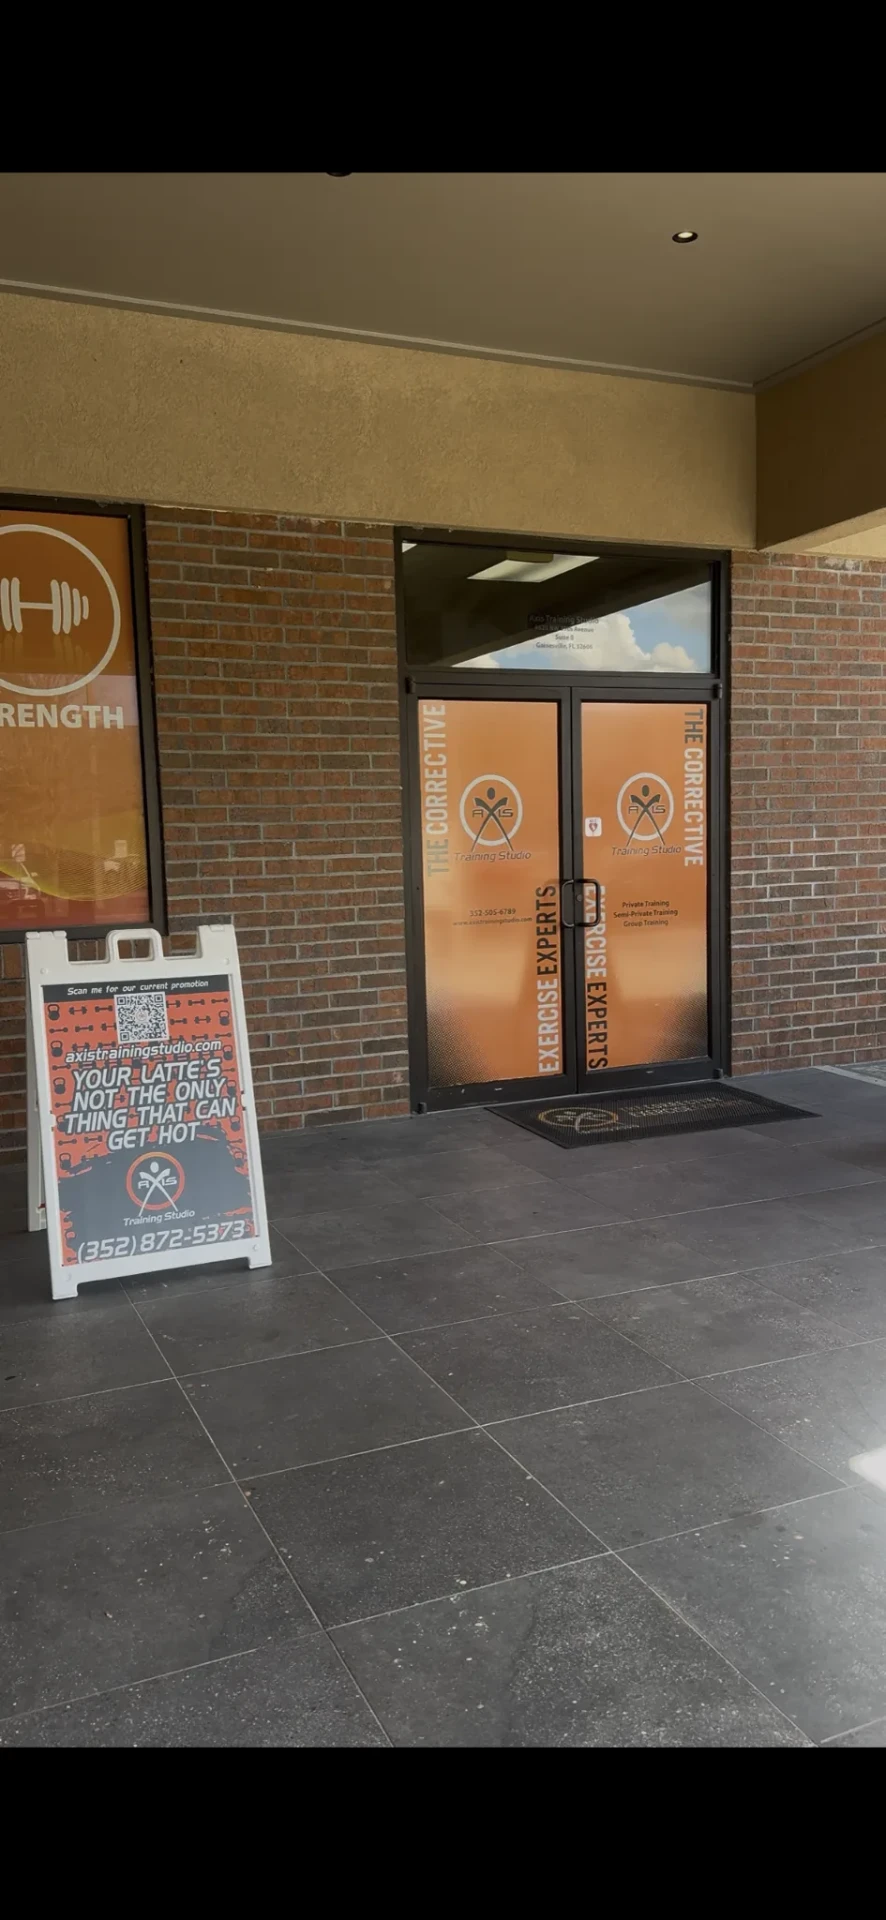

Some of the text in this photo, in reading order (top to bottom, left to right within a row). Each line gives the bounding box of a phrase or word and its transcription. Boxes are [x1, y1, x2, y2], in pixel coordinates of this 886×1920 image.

[546, 614, 575, 624] Training
[576, 616, 599, 624] Studio
[423, 705, 450, 878] THE CORRECTIVE
[684, 709, 704, 867] THE CORRECTIVE
[454, 850, 532, 863] Training Studio
[612, 845, 682, 857] Training Studio
[469, 908, 517, 918] 352-505-6789
[613, 908, 679, 919] Semi-Private Training
[622, 899, 670, 909] Private Training
[623, 918, 669, 928] Group Training
[67, 987, 88, 995] Scan
[91, 986, 103, 994] me
[106, 985, 118, 993] for
[140, 983, 168, 991] current
[171, 980, 209, 990] promotion
[535, 885, 559, 1073] EXERCISE EXPERTS
[587, 982, 609, 1070] EXPERTS
[65, 1041, 222, 1063] axistrainingstudio.com
[73, 1059, 222, 1090] YOUR LATTE'S
[73, 1078, 226, 1112] NOT THE ONLY
[65, 1098, 236, 1134] THING THAT CAN
[108, 1122, 200, 1150] GET HOT
[124, 1209, 195, 1226] Training Studio
